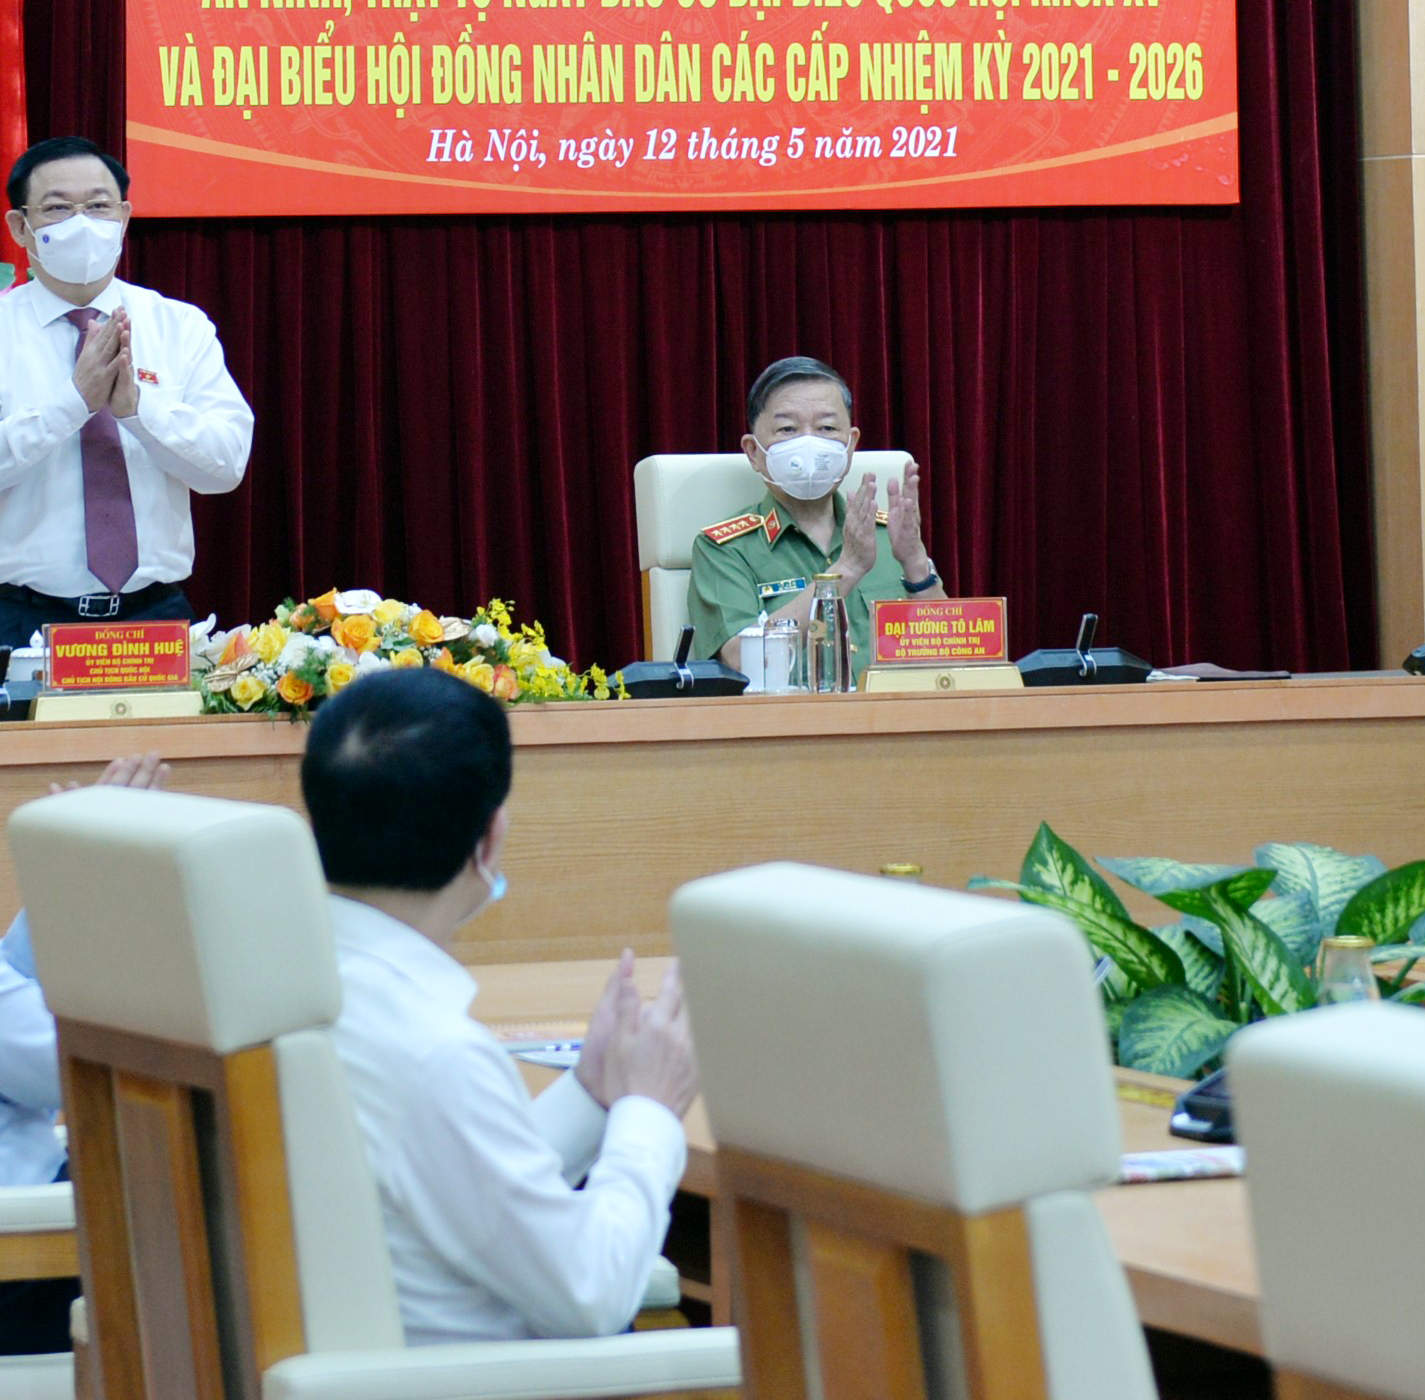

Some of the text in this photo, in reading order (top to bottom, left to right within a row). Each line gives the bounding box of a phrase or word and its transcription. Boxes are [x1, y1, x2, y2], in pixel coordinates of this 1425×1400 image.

[159, 20, 1203, 119] VÀ ĐẠI BIỂU HỘI ĐỒNG NHÂN DÂN CÁC CẤP NHIỆM KỲ 2021 - 2026
[427, 126, 957, 171] Hà Nội, ngày 12 tháng 5 năm 2021
[917, 605, 963, 616] ĐỒNG CHÍ
[95, 629, 145, 640] ĐỒNG CHÍ
[885, 618, 994, 638] ĐẠI TƯỚNG TÔ LÂM
[56, 639, 184, 657] VƯƠNG ĐÌNH HUỆ
